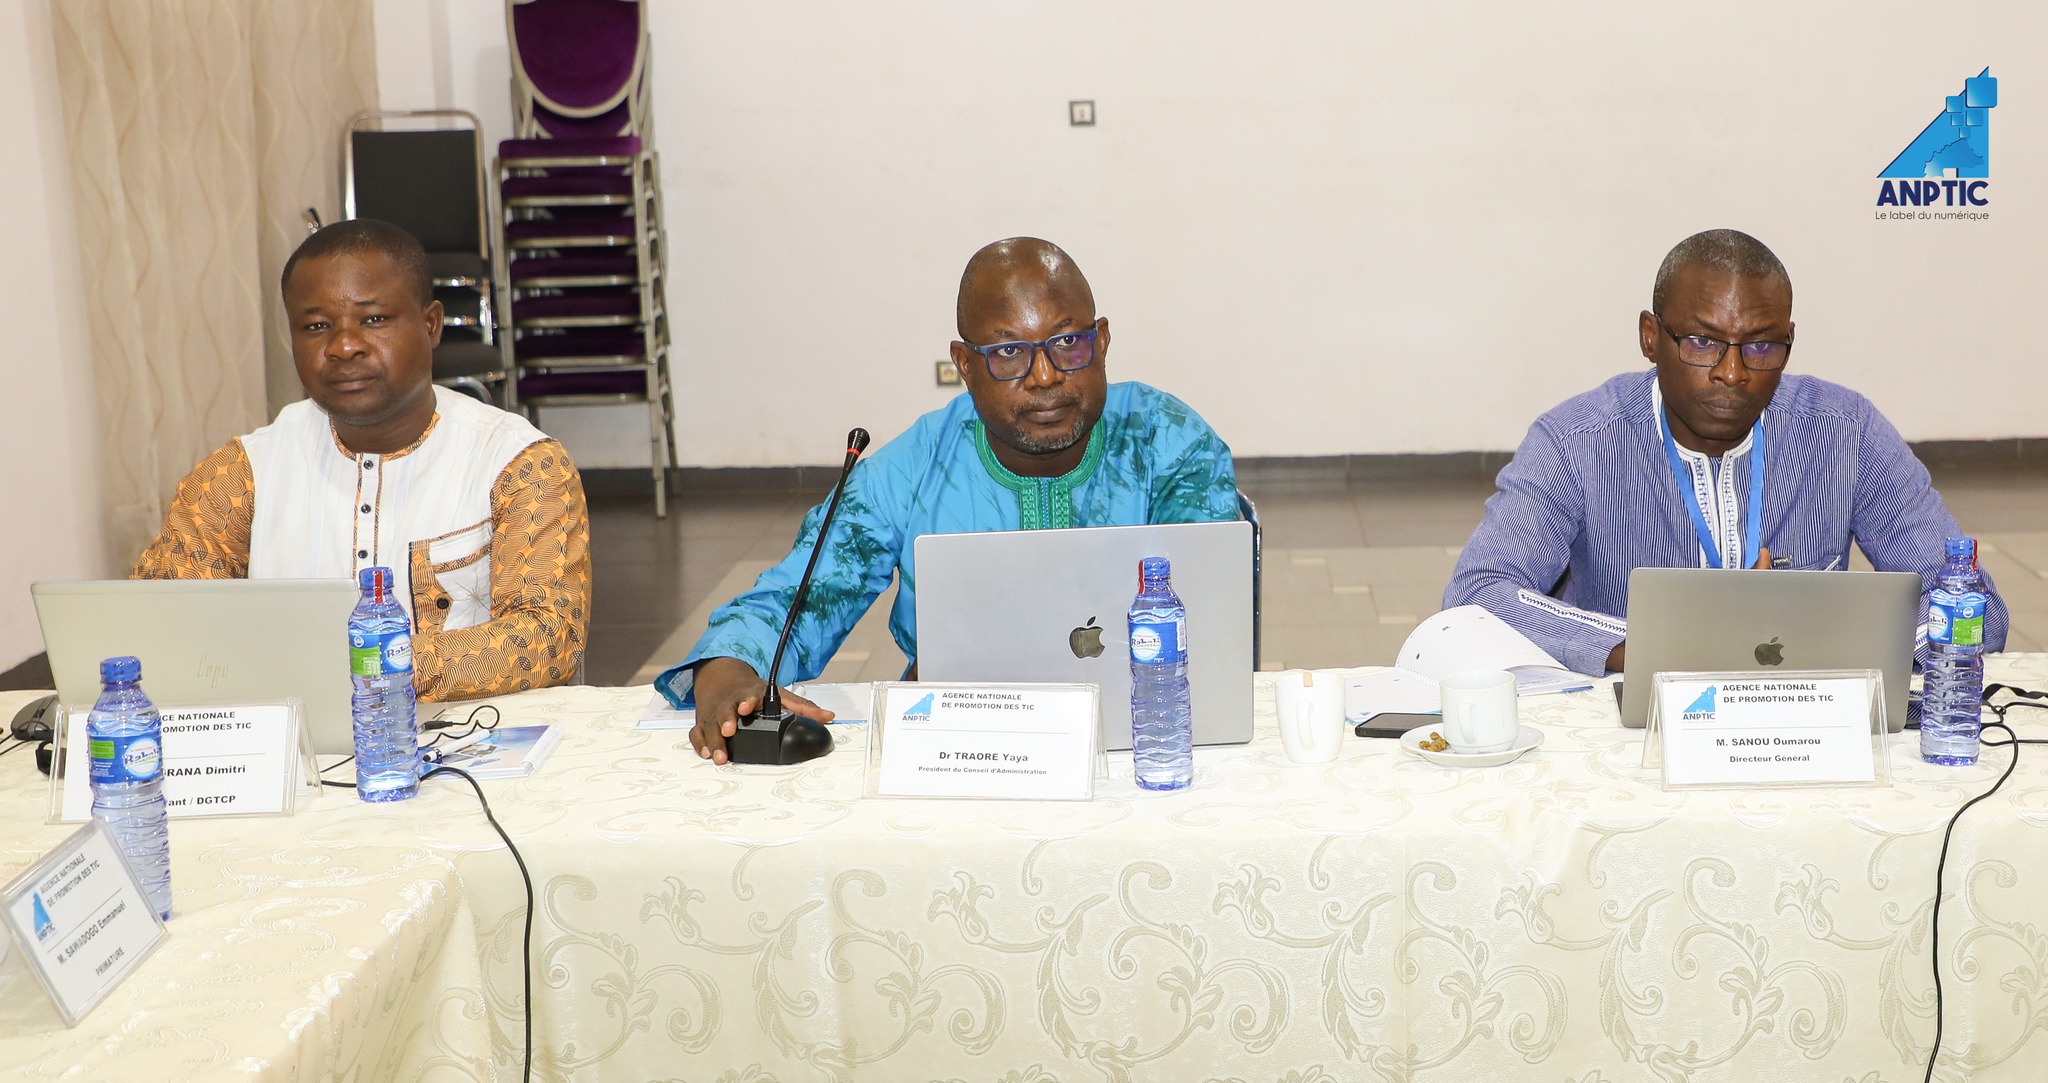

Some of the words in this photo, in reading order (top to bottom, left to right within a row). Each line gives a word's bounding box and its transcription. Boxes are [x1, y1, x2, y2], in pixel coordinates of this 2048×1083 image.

[942, 692, 974, 700] AGENCE
[976, 693, 1022, 701] NATIONALE
[1738, 695, 1794, 703] PROMOTION
[1818, 694, 1834, 702] TIC
[178, 711, 236, 721] NATIONALE
[162, 725, 210, 733] OMOTION
[213, 723, 232, 731] DES
[1716, 738, 1728, 746] M.
[1732, 738, 1770, 746] SANOU
[1773, 738, 1821, 746] Oumarou
[939, 751, 951, 760] Dr
[954, 752, 999, 761] TRAORE
[1002, 753, 1028, 763] Yaya
[206, 765, 246, 775] Dimitri
[196, 795, 236, 805] DGTCP
[40, 874, 60, 894] AGENCE
[59, 853, 86, 878] NATIONALE
[46, 897, 56, 907] DE
[54, 874, 82, 900] PROMOTION
[81, 867, 92, 879] DES
[90, 860, 100, 871] TIC
[57, 954, 67, 965] M.
[65, 924, 99, 958] SAWADOGO
[97, 900, 127, 929] Emmanuel
[95, 946, 124, 976] PRIMATURE
